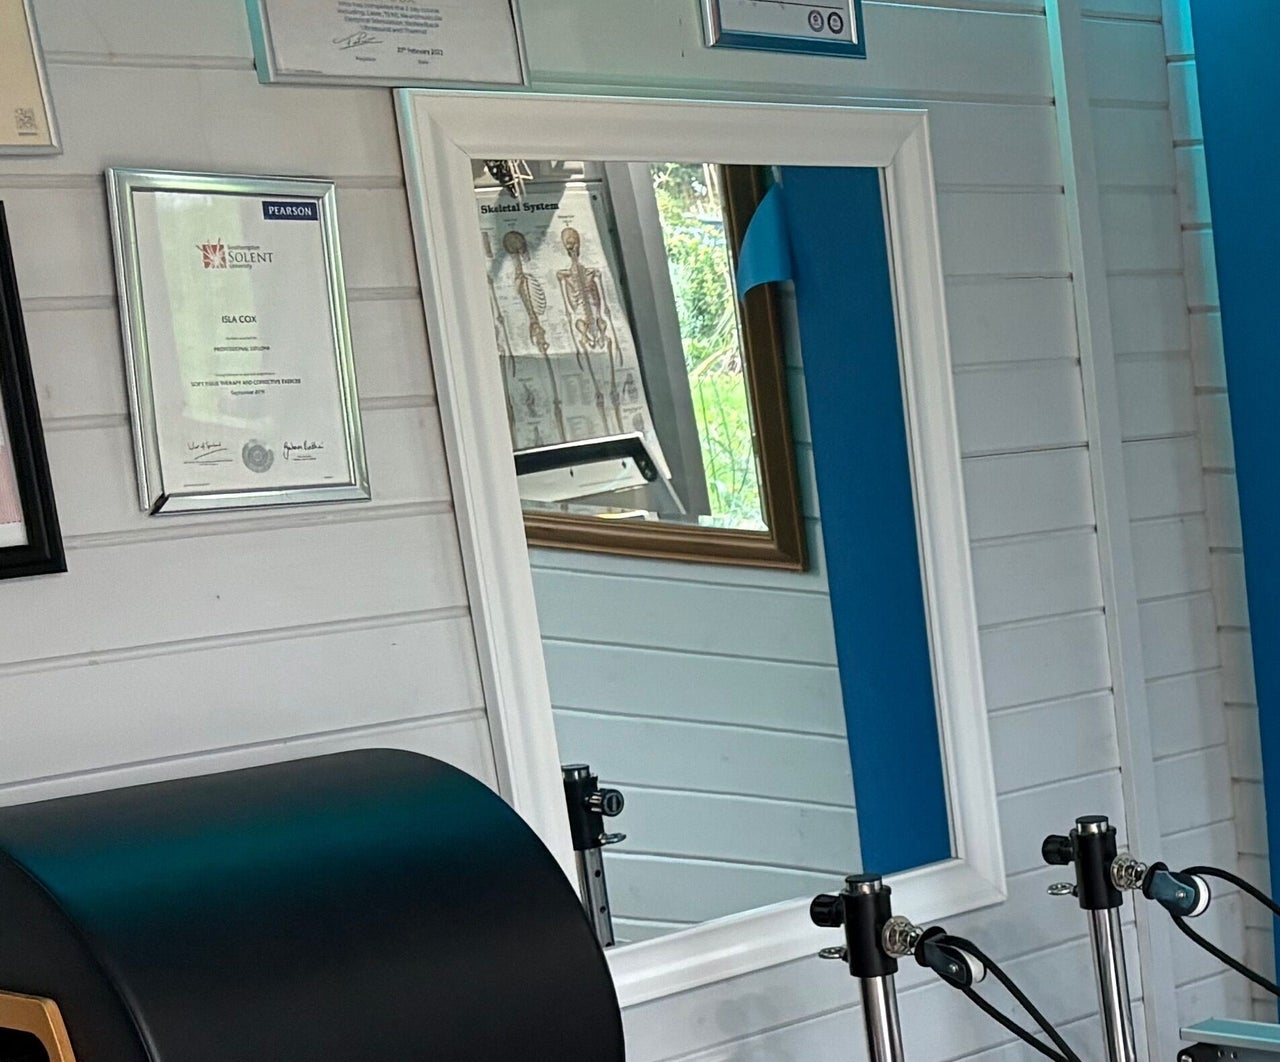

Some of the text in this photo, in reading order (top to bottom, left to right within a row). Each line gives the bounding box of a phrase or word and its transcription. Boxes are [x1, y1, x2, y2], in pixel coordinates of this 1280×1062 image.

[267, 205, 313, 217] PEARSON
[480, 201, 559, 214] Skeletal System
[221, 315, 257, 324] ISLA COX
